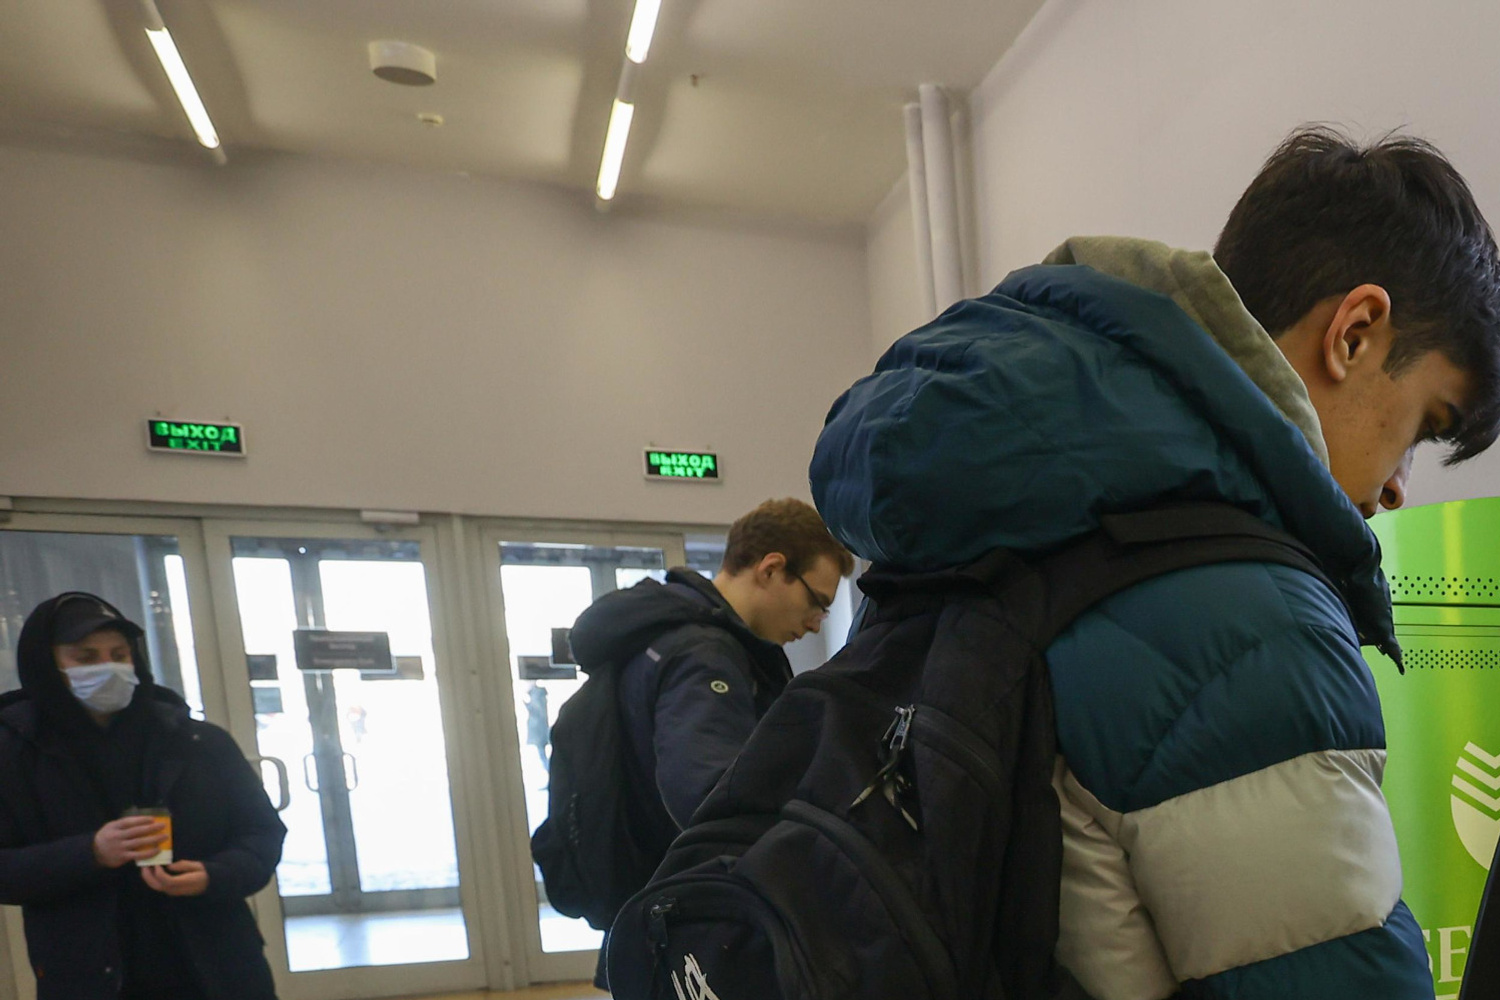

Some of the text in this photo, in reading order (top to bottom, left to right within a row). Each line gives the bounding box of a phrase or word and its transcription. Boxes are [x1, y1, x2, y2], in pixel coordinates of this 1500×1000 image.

[154, 421, 237, 443] ВЫХОД
[168, 438, 224, 452] EXIT
[649, 452, 716, 471] ВЫХОД
